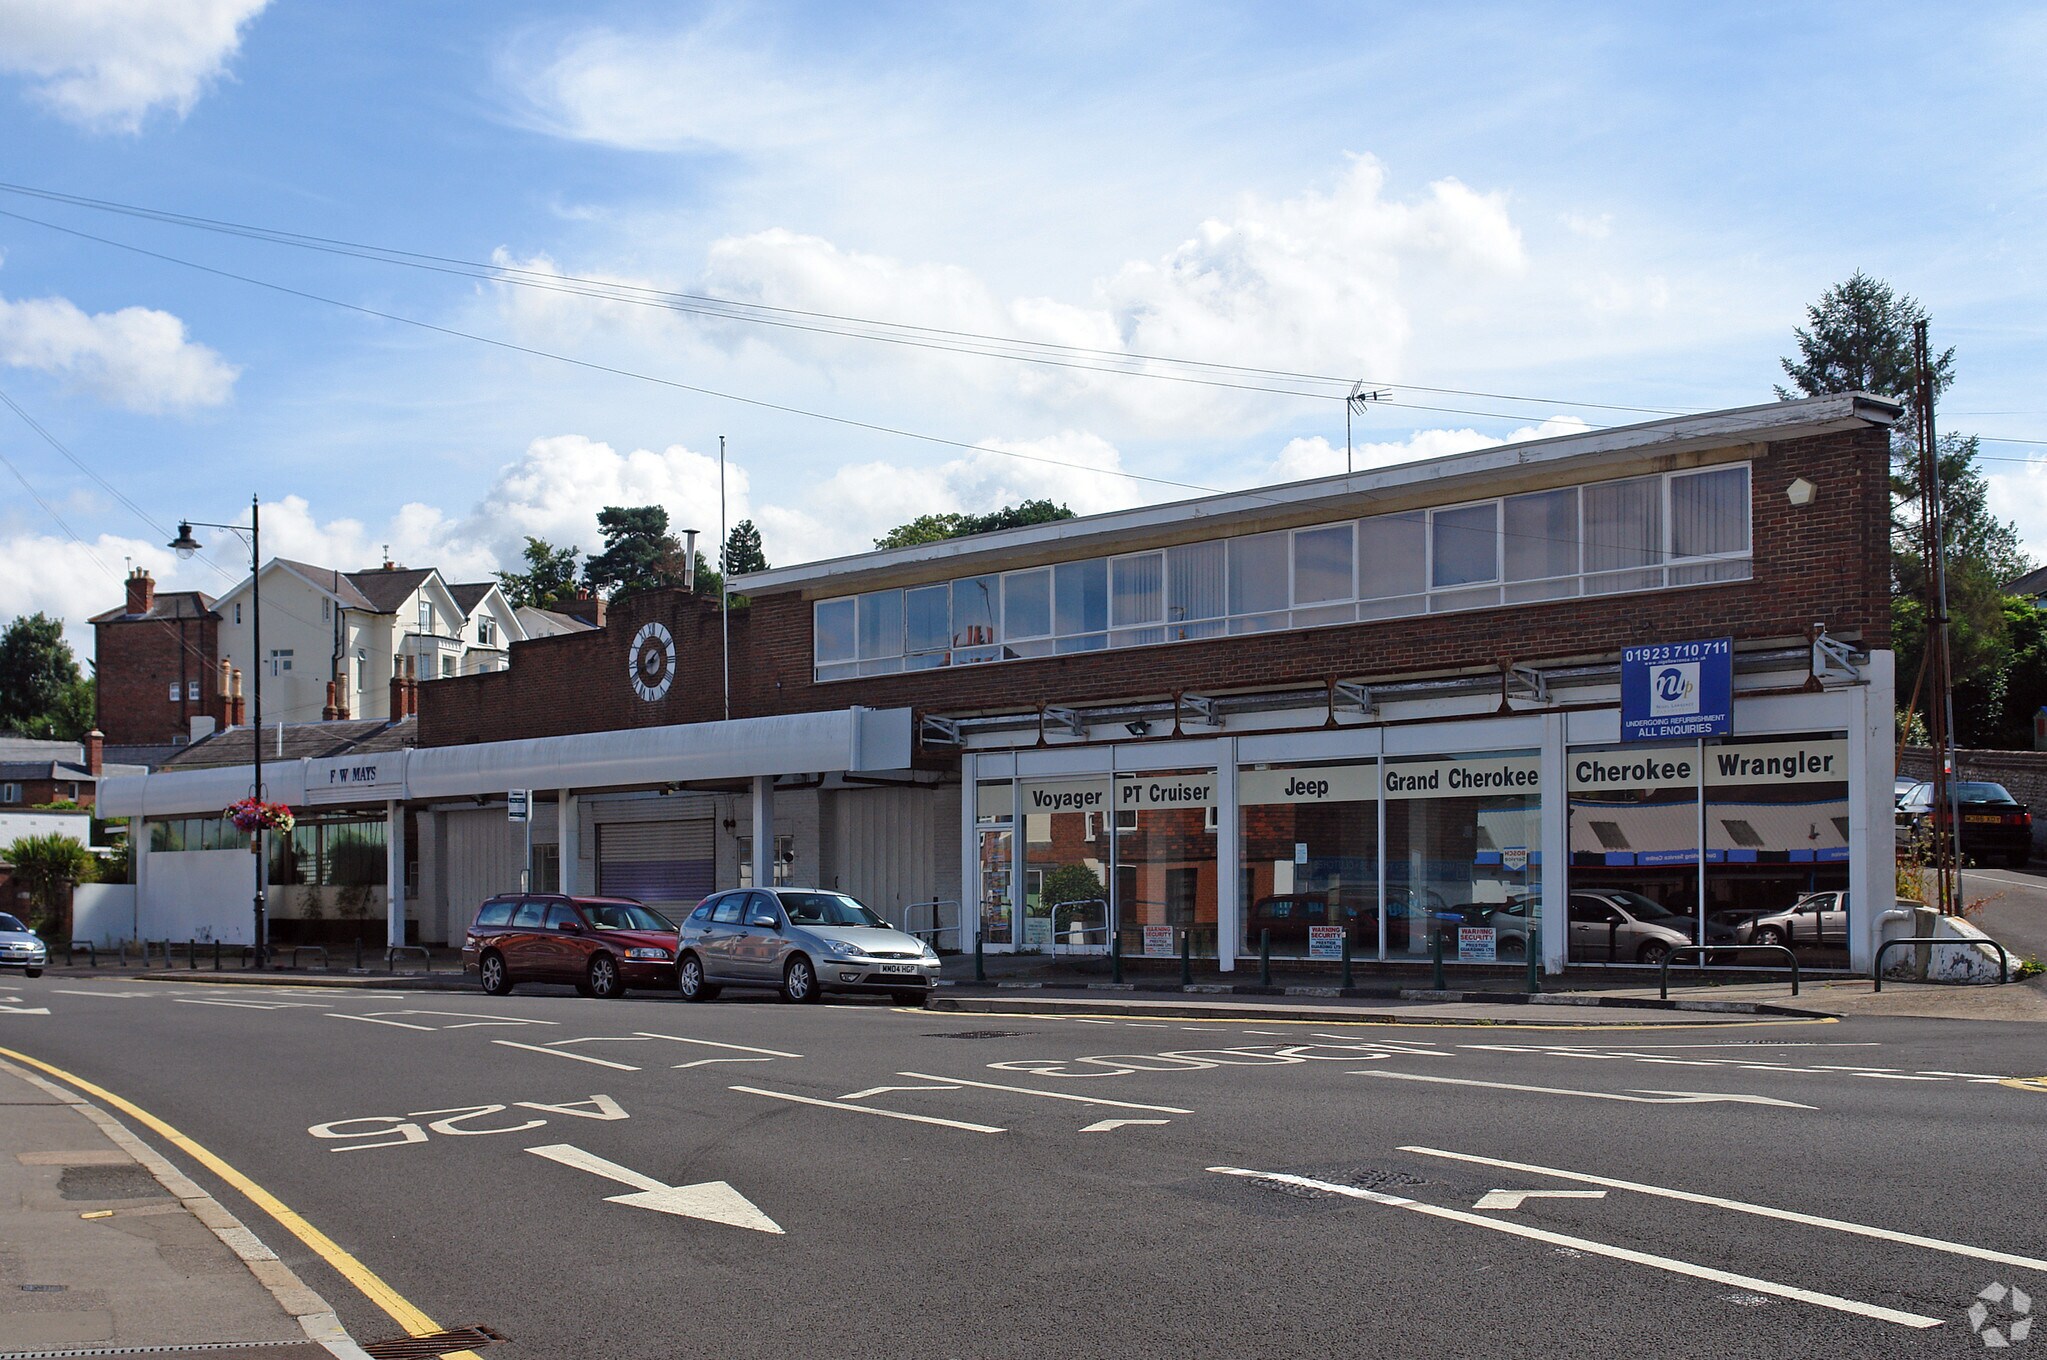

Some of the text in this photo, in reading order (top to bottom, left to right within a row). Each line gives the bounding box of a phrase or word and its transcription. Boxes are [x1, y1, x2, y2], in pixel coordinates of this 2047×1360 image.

[1626, 642, 1728, 662] 01923 710 711
[1626, 714, 1726, 728] UNDERGOING REFURBISHMENT
[1638, 724, 1712, 737] ALL ENQUIRIES
[330, 766, 376, 783] F W MAYS
[1576, 750, 1833, 782] Cherokee Wrangler
[1284, 777, 1329, 798] Jeep
[1386, 766, 1538, 791] Grand Cherokee
[1033, 790, 1102, 810] Voyager
[1123, 783, 1210, 803] PT Cruiser
[306, 1094, 631, 1152] A25
